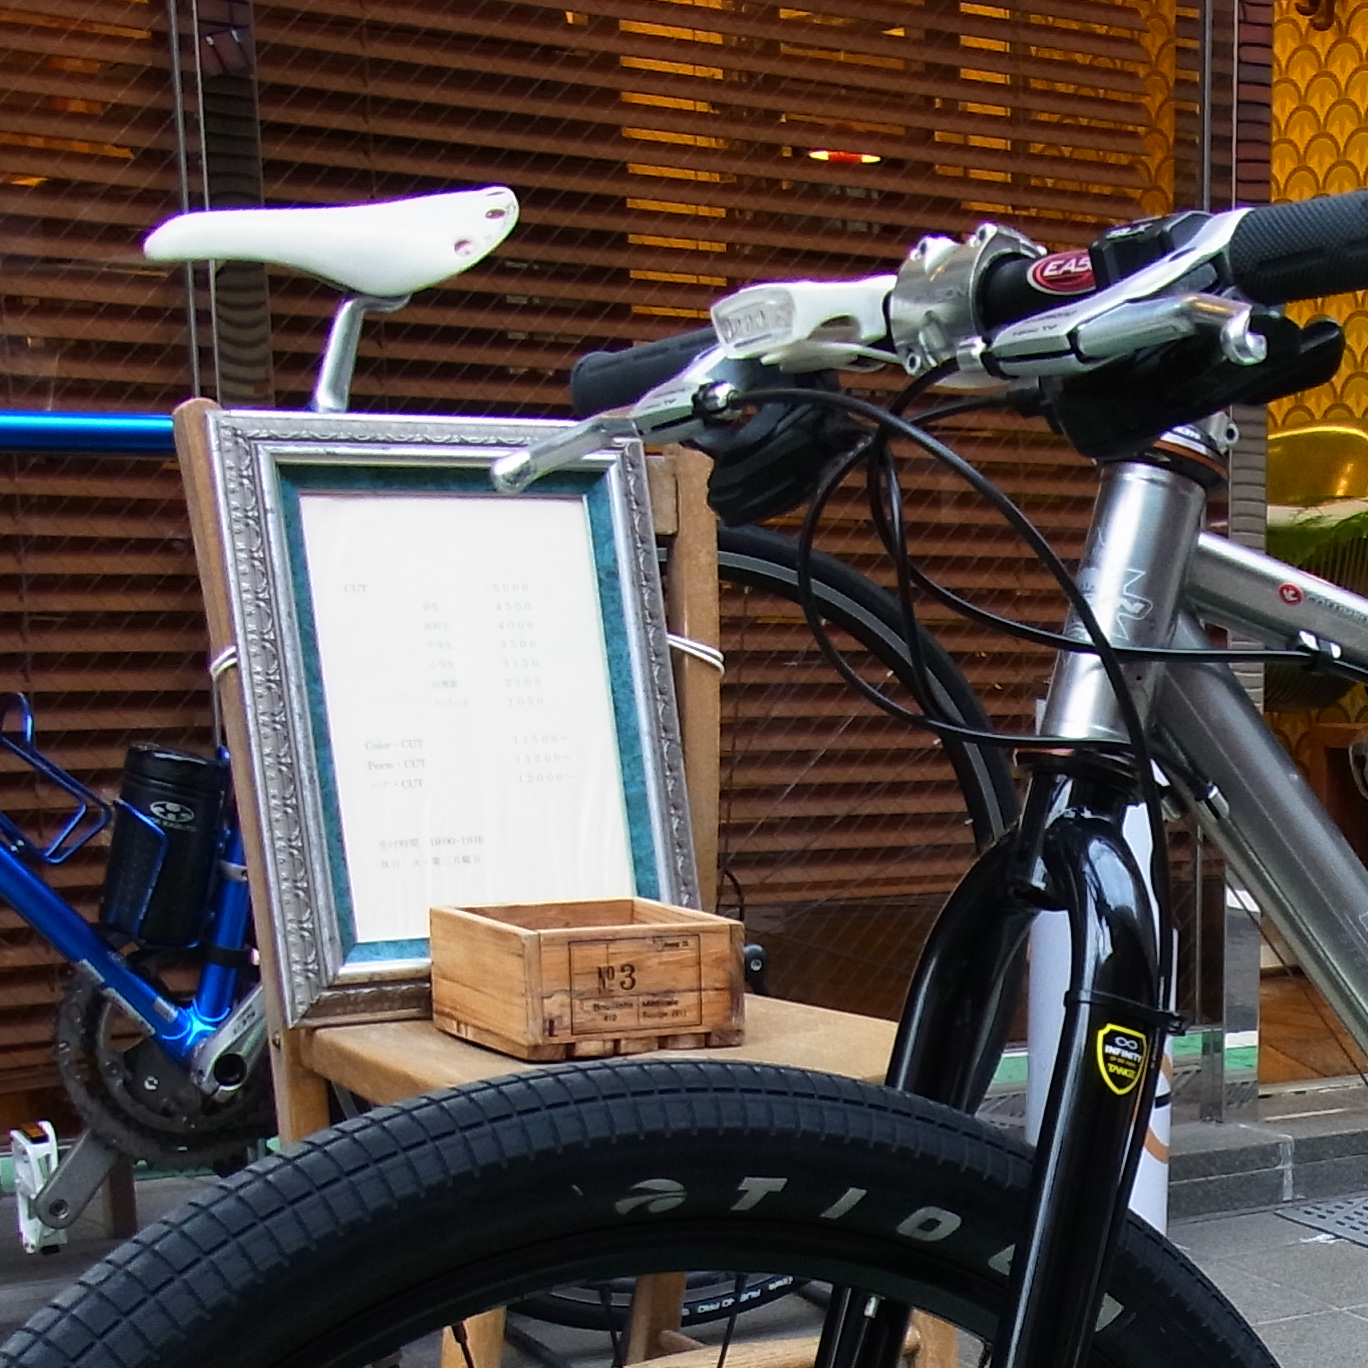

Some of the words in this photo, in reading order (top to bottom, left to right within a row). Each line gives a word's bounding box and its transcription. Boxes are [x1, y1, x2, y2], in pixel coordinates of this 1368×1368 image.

[1043, 257, 1093, 278] EAS
[344, 583, 368, 594] CUT
[620, 963, 637, 991] 3
